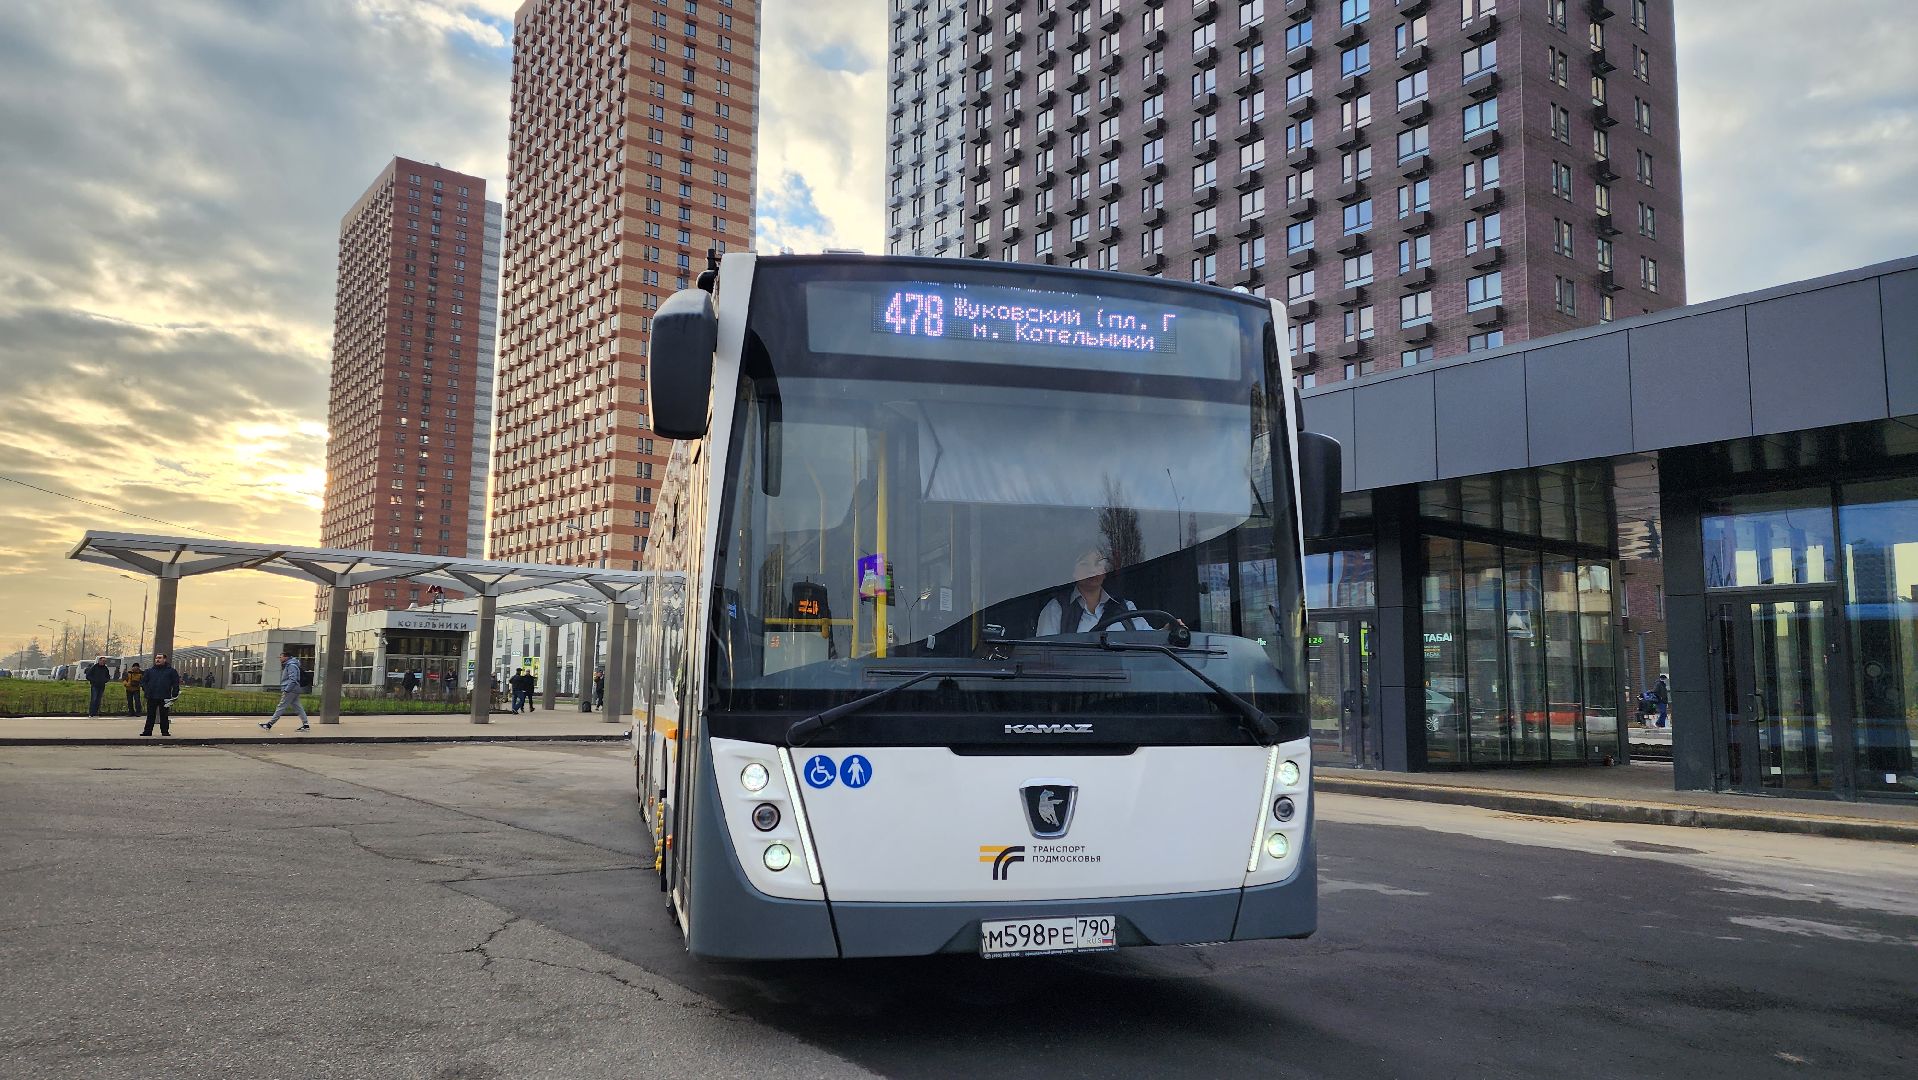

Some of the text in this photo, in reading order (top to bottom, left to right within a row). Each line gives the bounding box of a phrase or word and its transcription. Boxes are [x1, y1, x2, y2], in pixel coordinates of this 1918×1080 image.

[885, 292, 944, 337] 478
[954, 297, 1081, 326] Жуковский
[1097, 308, 1147, 331] (пл.
[973, 322, 1155, 350] м. Котельники
[397, 620, 467, 630] КОТЕЛЬНИКИ
[1004, 723, 1094, 734] KAMAZ
[1032, 845, 1086, 853] ТРАНСПОРТ
[1032, 855, 1101, 863] ПОДМОСКОВЬЯ
[988, 918, 1110, 949] М598РЕ 790
[1087, 937, 1102, 945] RUS
